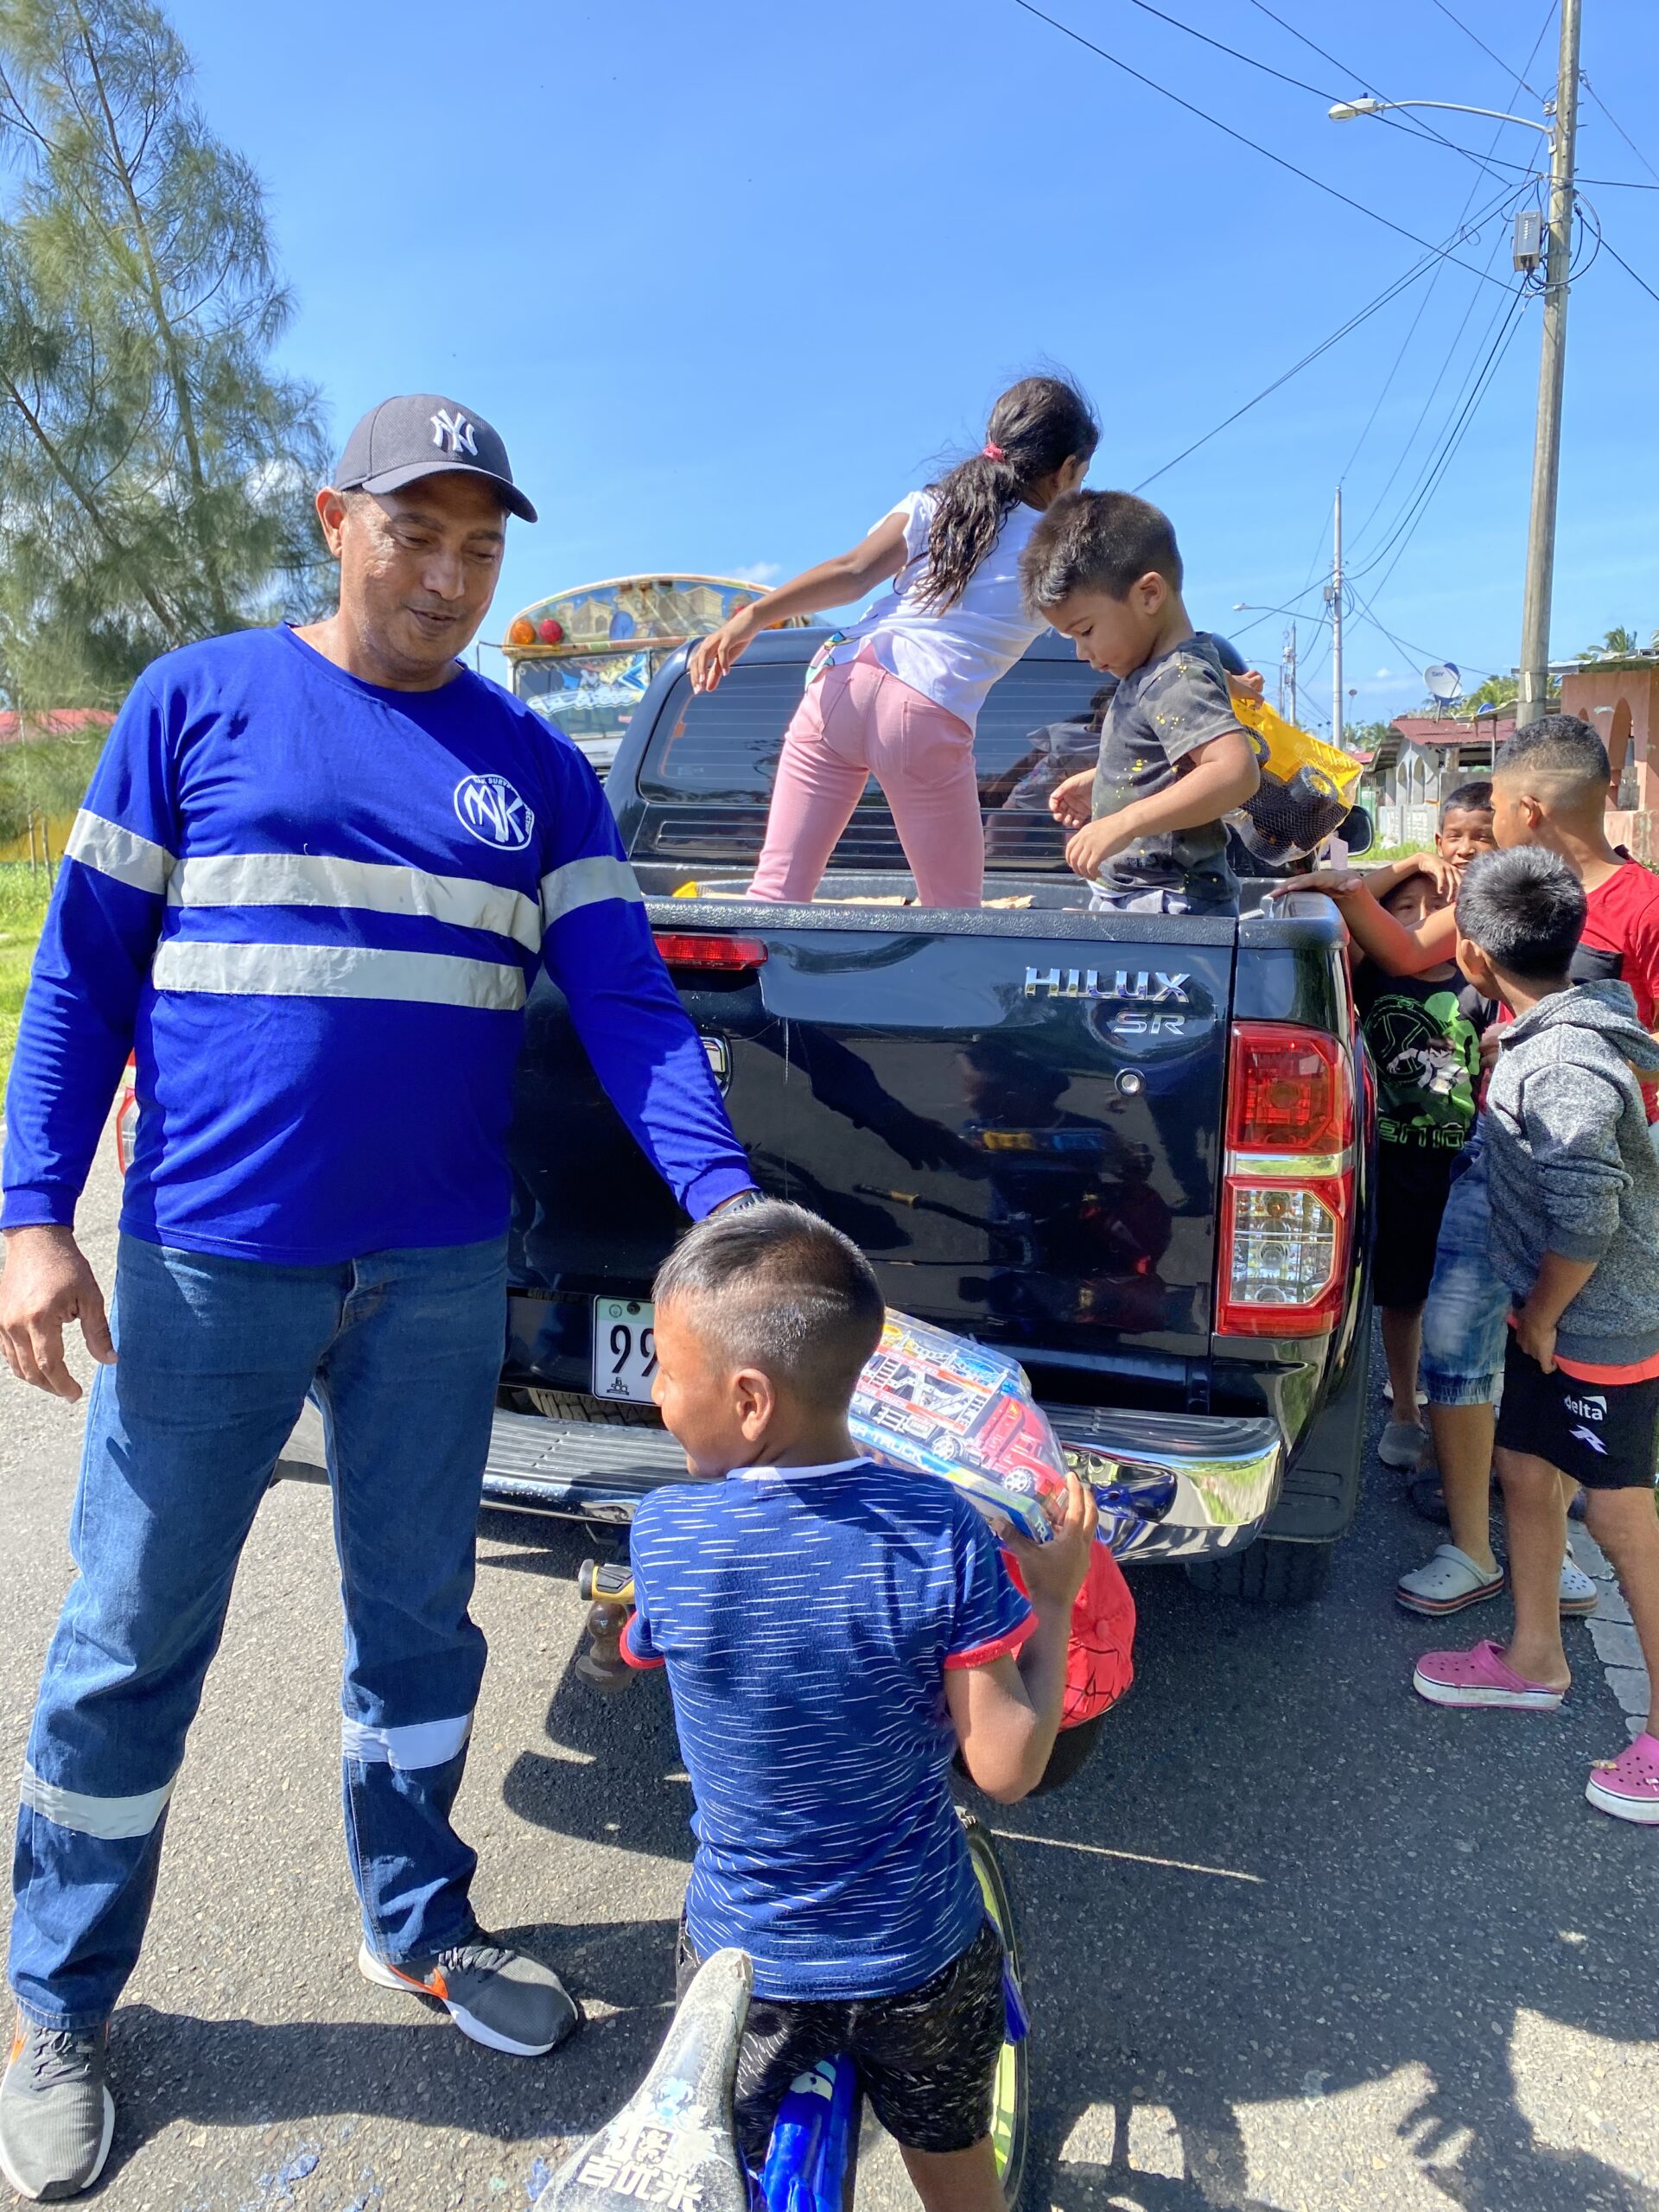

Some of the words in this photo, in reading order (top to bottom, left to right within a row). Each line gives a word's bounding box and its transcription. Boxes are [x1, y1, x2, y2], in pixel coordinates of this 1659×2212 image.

[430, 409, 478, 456] NY
[1025, 967, 1191, 1003] HILUX
[1113, 1012, 1185, 1035] SR
[1564, 1394, 1603, 1421] delta
[870, 1430, 925, 1465] TRUCK
